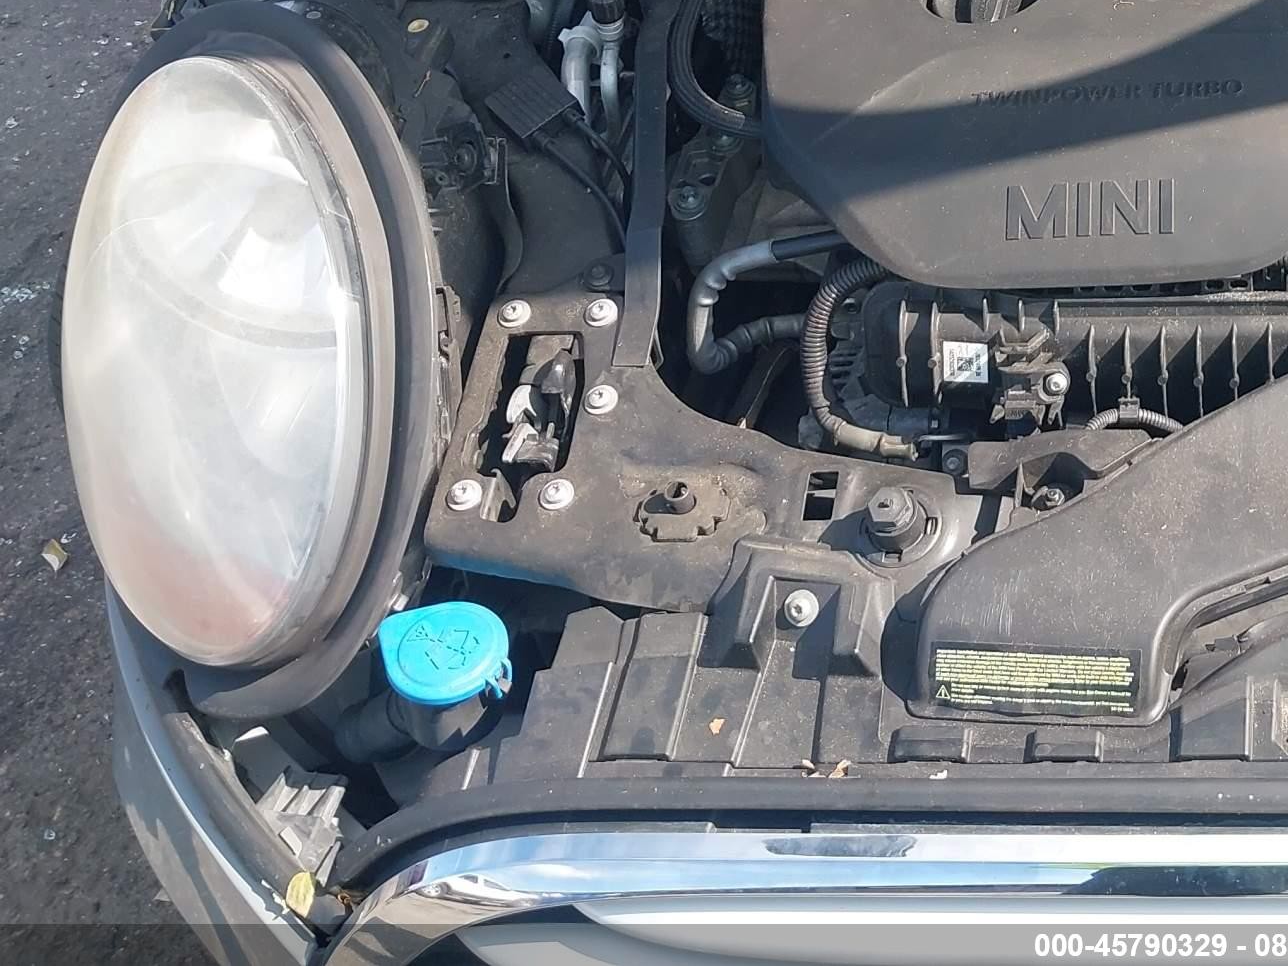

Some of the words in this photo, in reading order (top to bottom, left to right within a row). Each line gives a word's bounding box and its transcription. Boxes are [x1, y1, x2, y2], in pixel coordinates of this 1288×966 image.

[971, 87, 1143, 107] TWINPOWER
[1150, 79, 1244, 100] TURBO
[1006, 178, 1175, 241] MINI
